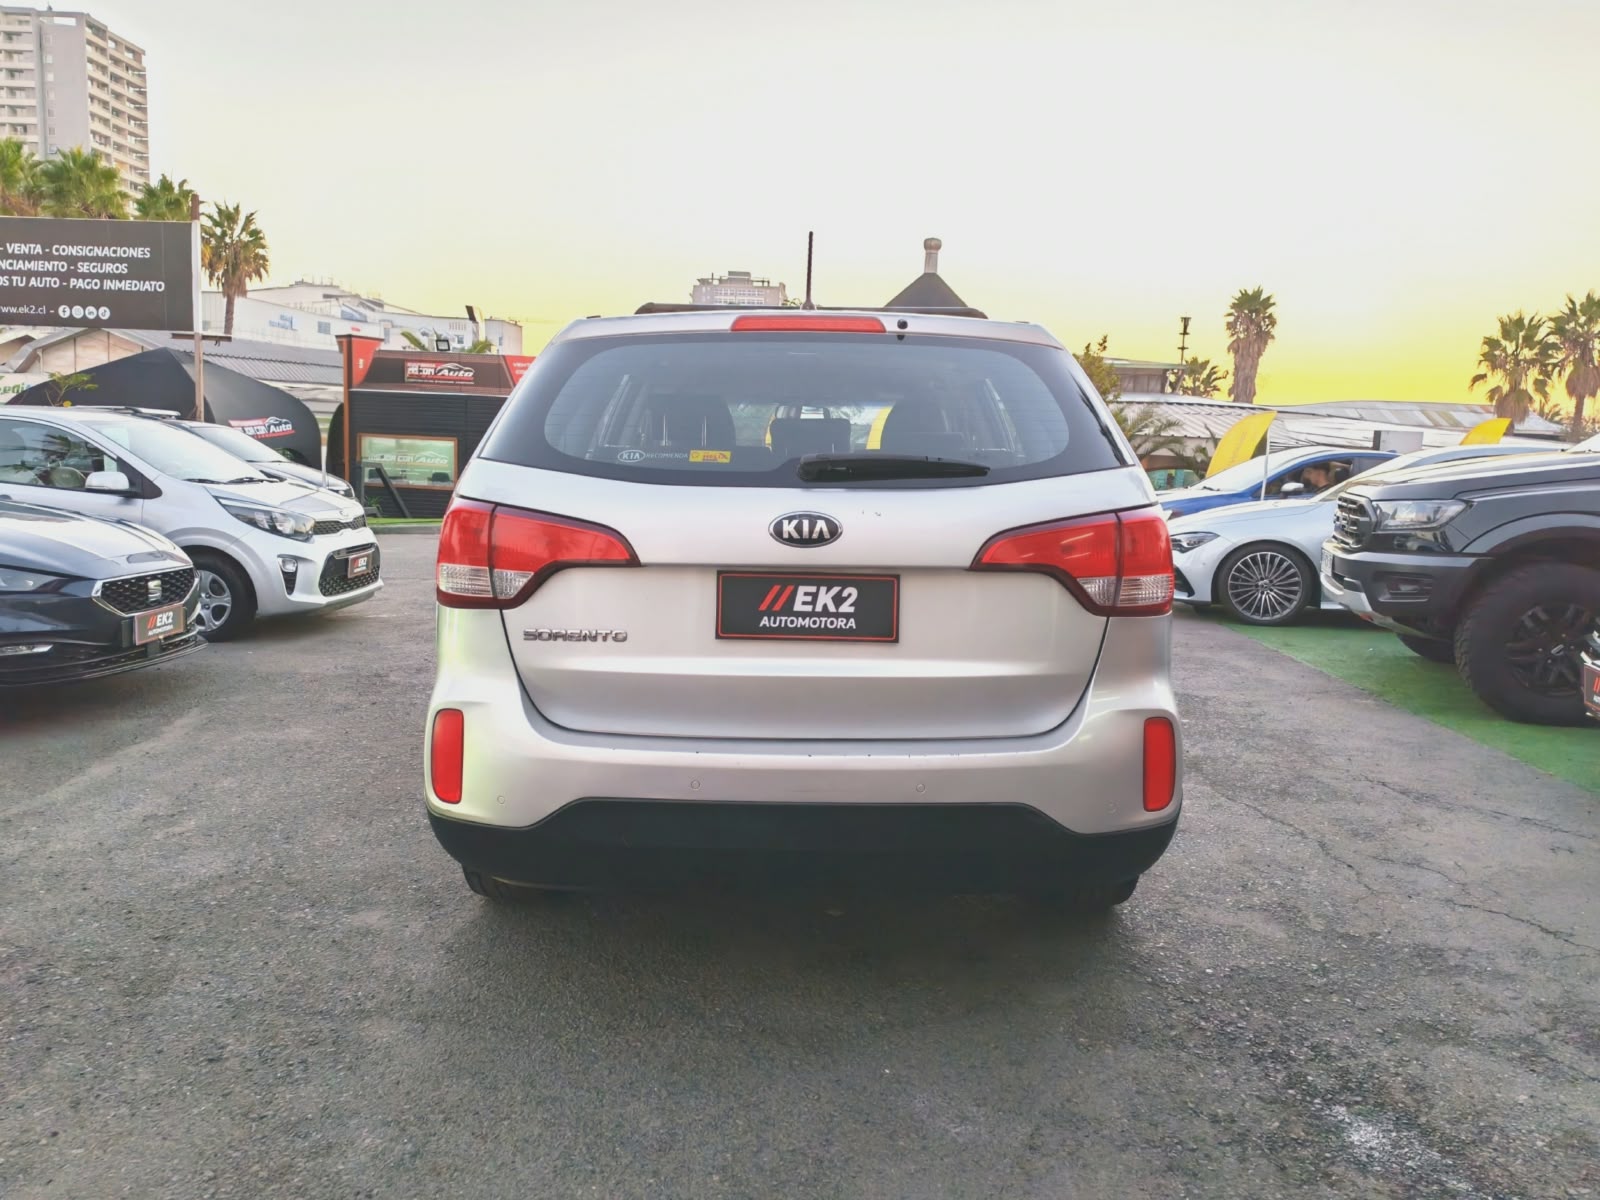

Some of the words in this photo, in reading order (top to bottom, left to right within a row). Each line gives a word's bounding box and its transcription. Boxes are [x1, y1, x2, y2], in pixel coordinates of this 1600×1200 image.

[6, 243, 42, 255] VENTA
[52, 245, 151, 258] CONSIGNACIONES
[77, 262, 128, 274] SEGUROS
[11, 276, 26, 287] TU
[29, 277, 60, 288] AUTO
[69, 278, 100, 290] PAGO
[103, 279, 165, 292] INMEDIATO
[270, 423, 292, 434] Auto
[622, 452, 640, 460] KIA
[782, 519, 830, 539] KIA
[759, 616, 856, 629] AUTOMOTORA
[523, 628, 627, 643] SORENTO
